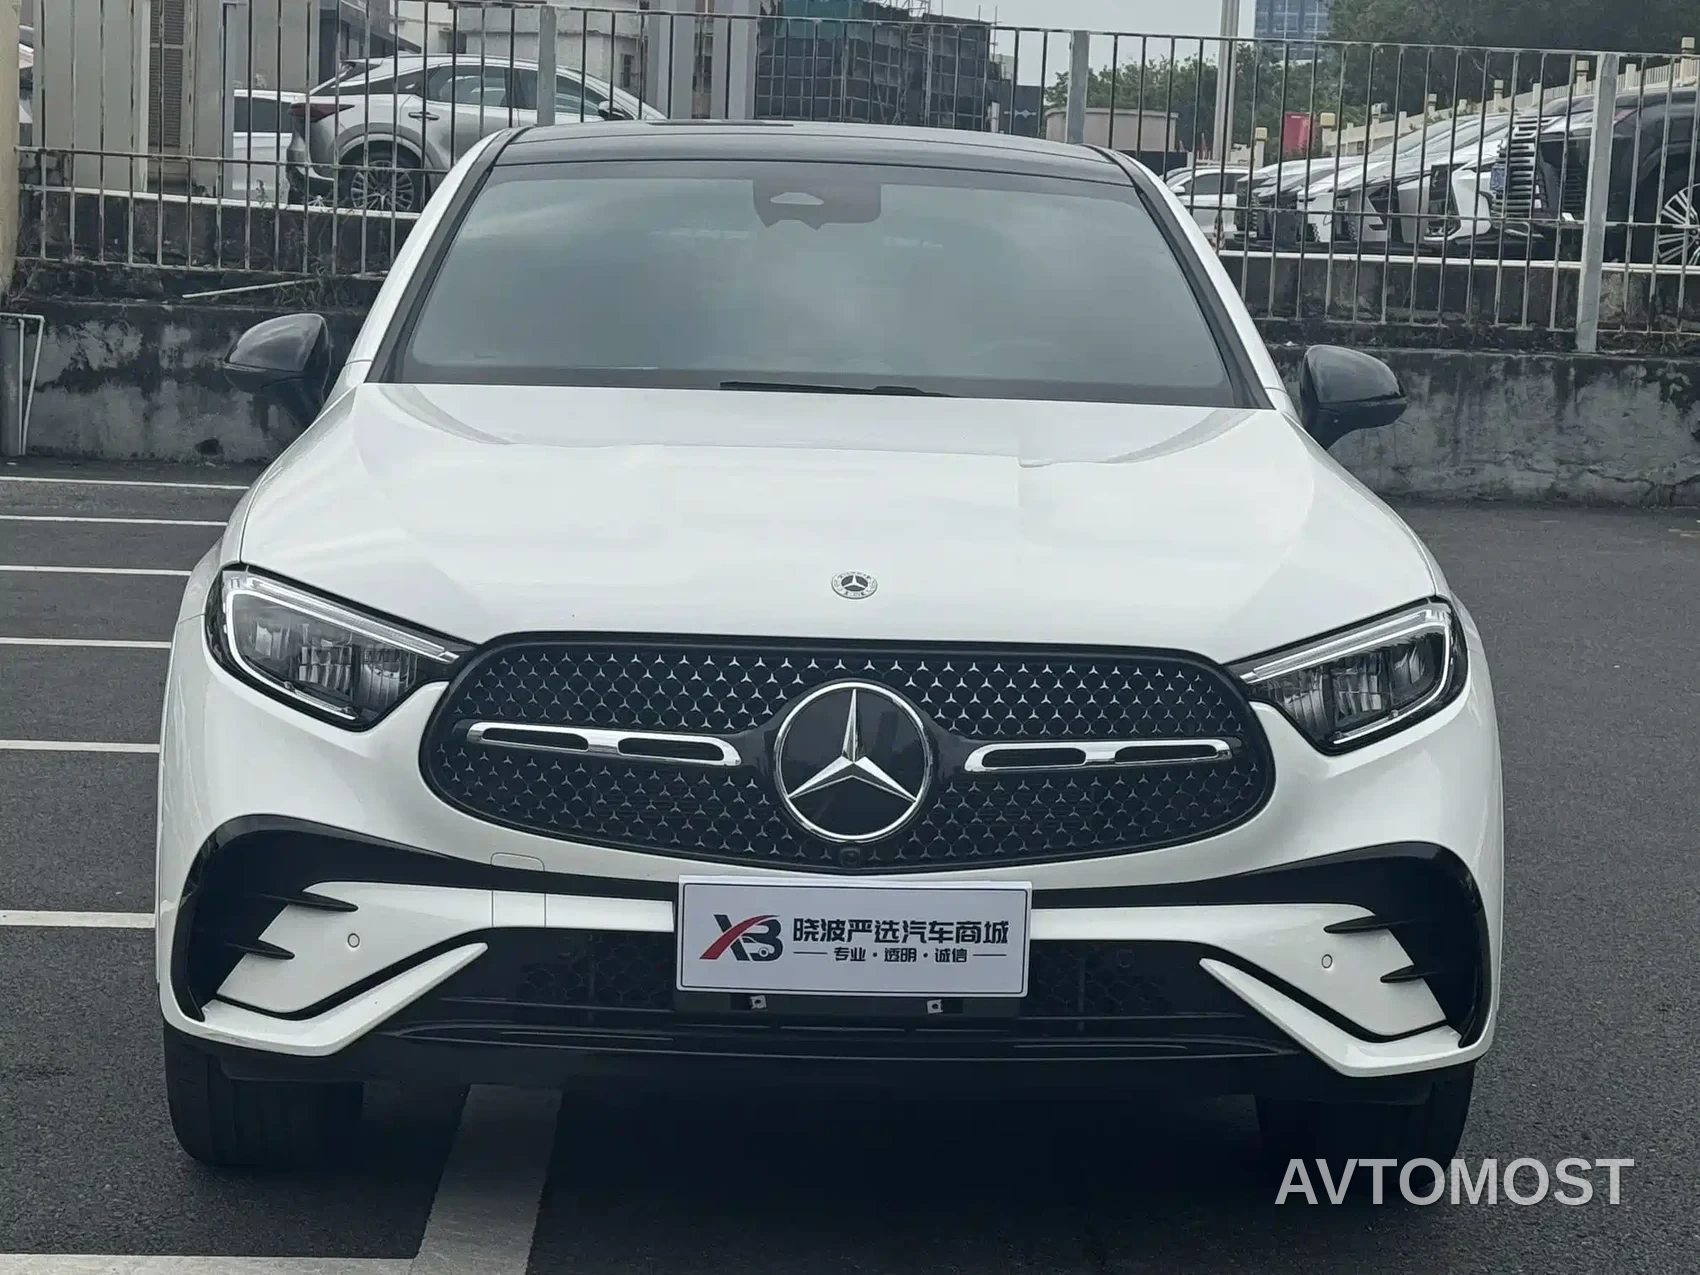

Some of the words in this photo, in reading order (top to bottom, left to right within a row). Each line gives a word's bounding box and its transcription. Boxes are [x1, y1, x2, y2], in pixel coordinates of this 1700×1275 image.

[793, 918, 1009, 945] 晓波严选汽车商城
